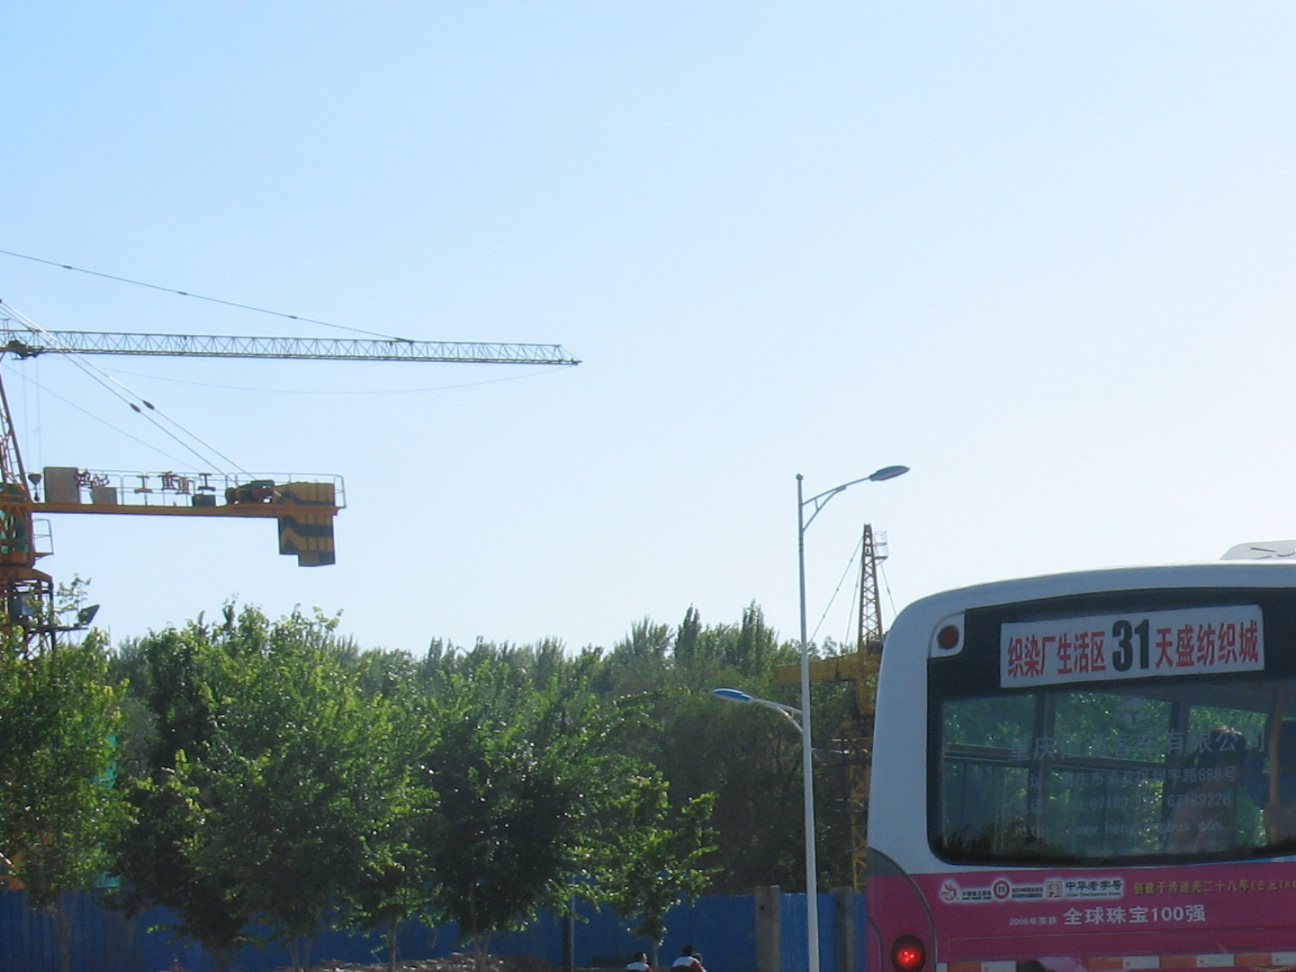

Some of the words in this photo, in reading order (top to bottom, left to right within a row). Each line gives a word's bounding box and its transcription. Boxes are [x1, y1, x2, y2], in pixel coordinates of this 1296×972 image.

[1007, 631, 1107, 678] 织染厂生活区
[1112, 619, 1150, 672] 31
[1155, 620, 1259, 668] 天盛纺织城
[1063, 904, 1206, 925] 全球珠宝100强
